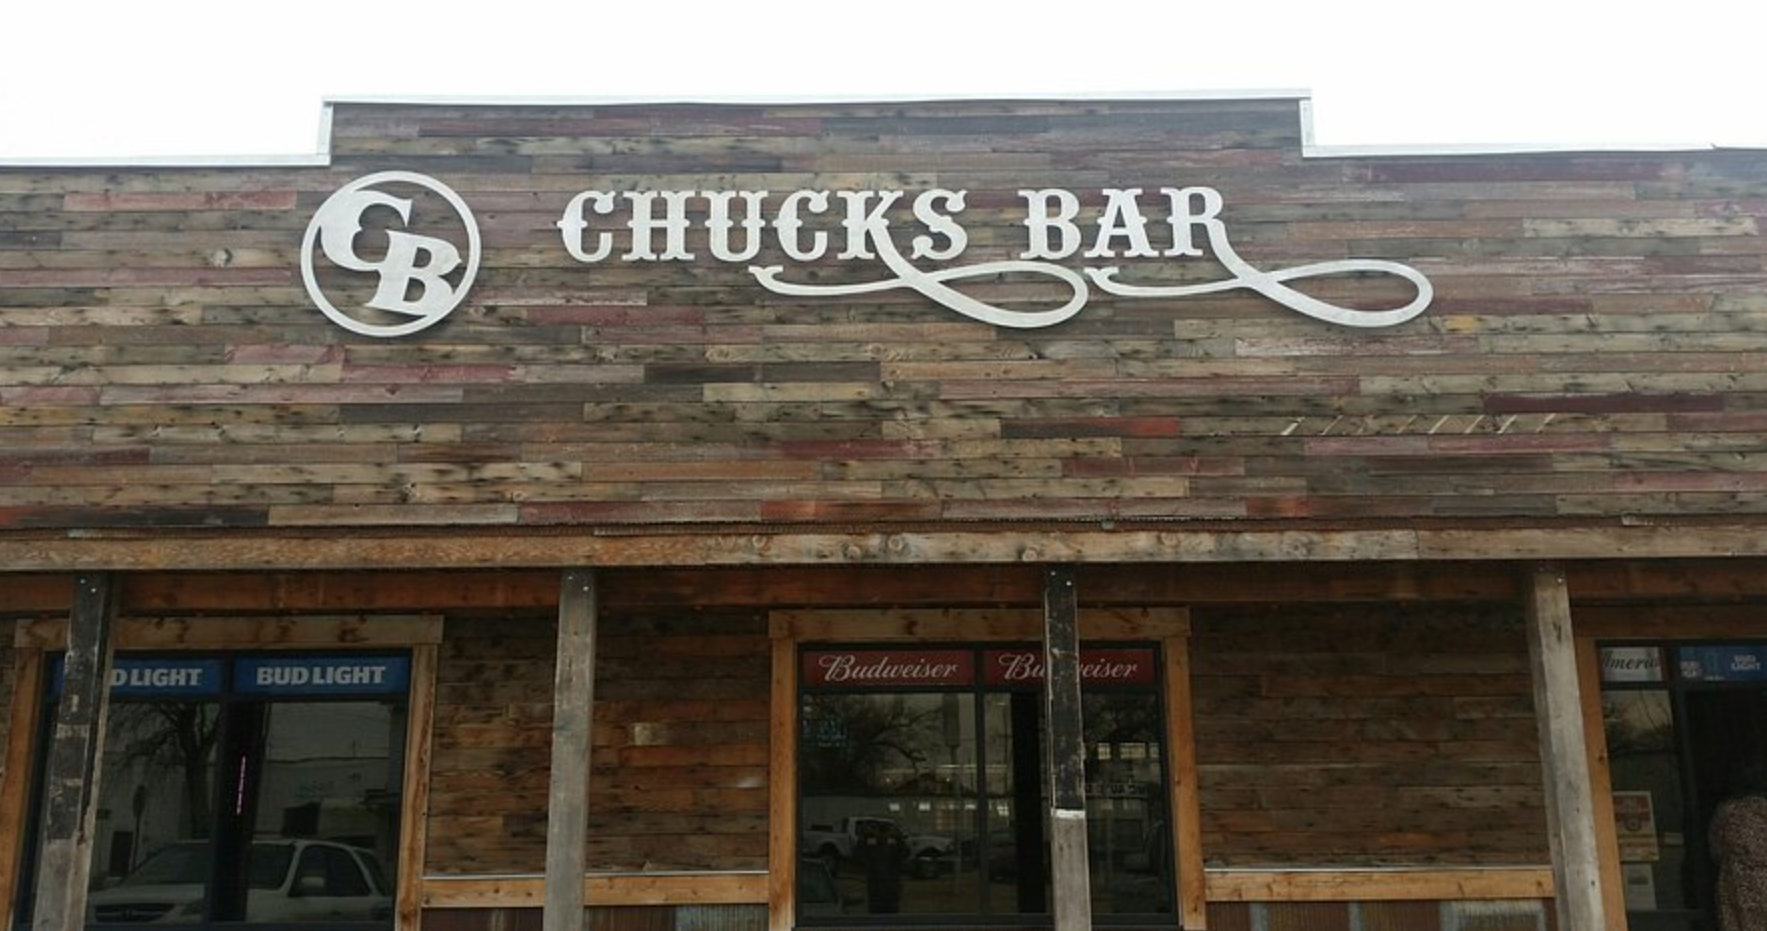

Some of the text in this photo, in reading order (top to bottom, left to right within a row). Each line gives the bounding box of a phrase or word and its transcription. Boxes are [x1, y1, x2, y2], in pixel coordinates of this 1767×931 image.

[557, 188, 968, 281] CHUCKS
[130, 668, 203, 687] LIGHT
[256, 665, 386, 685] BUD LIGHT
[819, 653, 957, 682] Budweiser
[999, 653, 1137, 681] Bueiser
